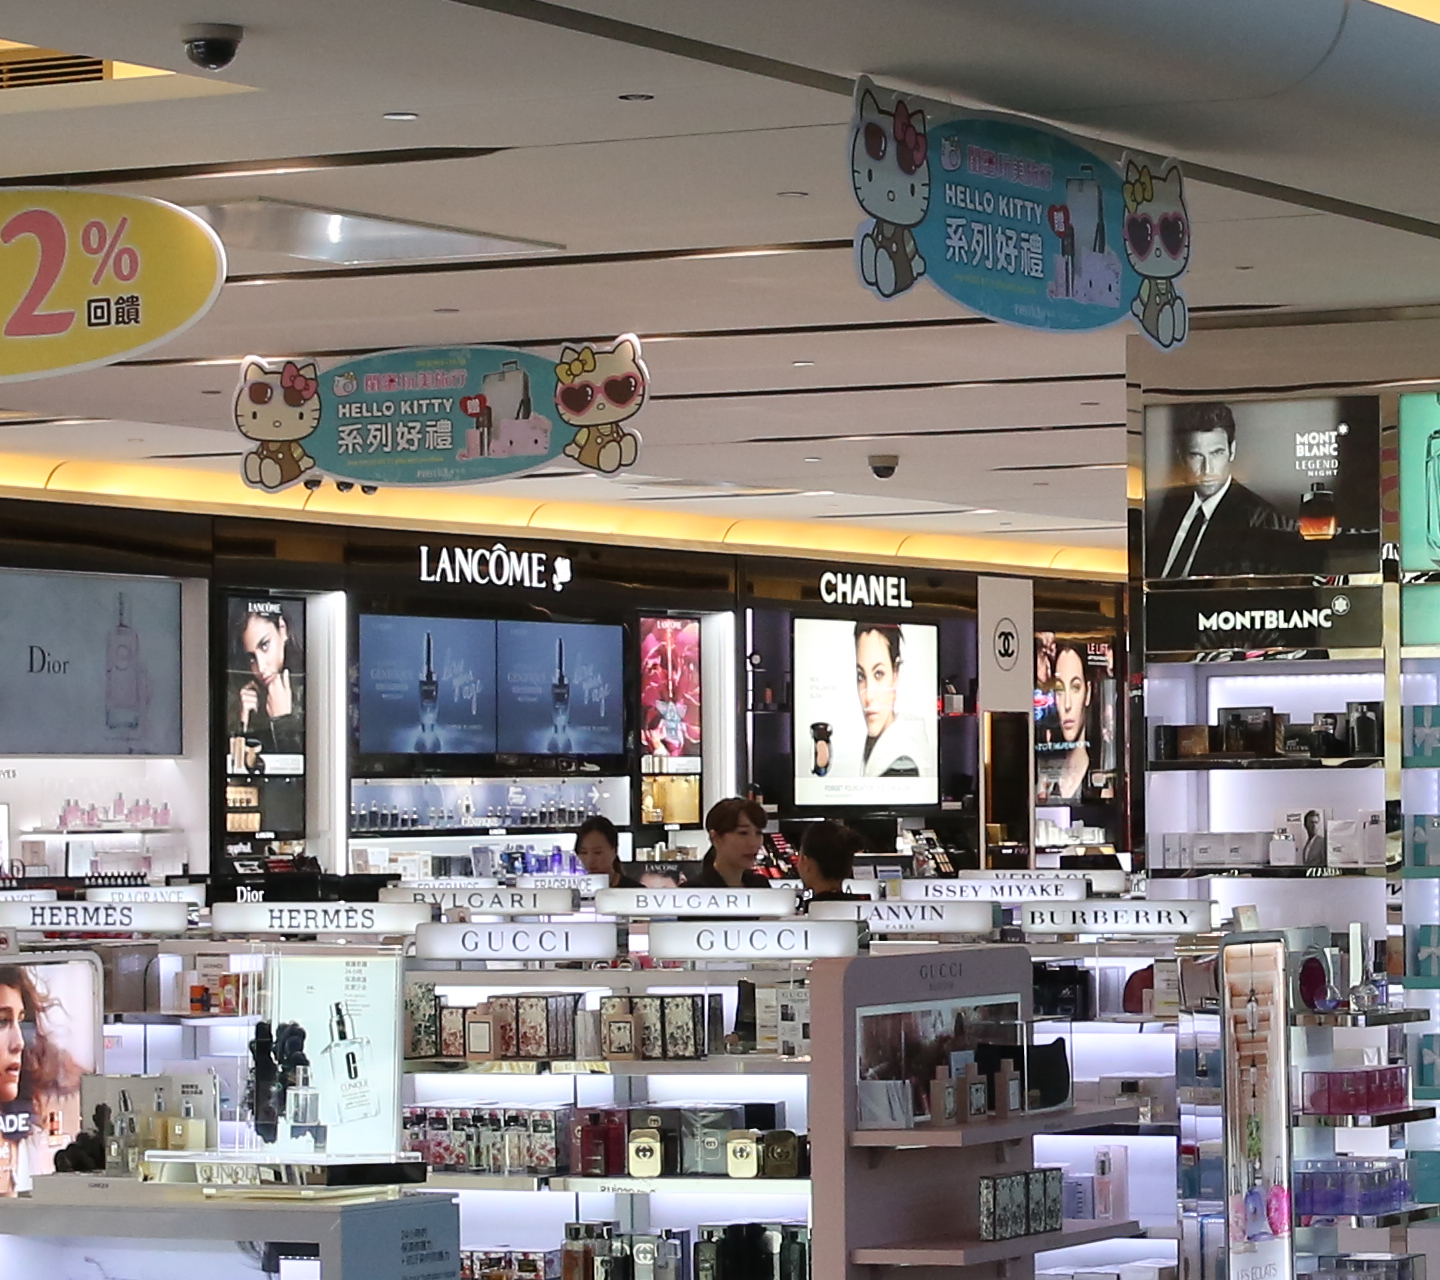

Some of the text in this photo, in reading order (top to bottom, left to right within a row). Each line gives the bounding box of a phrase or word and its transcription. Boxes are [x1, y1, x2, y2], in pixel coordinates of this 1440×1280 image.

[945, 183, 1043, 224] HELLO KITTY
[945, 217, 1044, 280] 系列好禮
[0, 208, 140, 337] 2%
[86, 295, 141, 327] 回饋
[337, 397, 454, 419] HELLO KITTY
[337, 420, 454, 455] 系列好禮
[1295, 431, 1338, 445] MONT
[1296, 443, 1338, 457] BLANC
[1295, 459, 1338, 470] LEGEND
[419, 543, 547, 589] LANCÔME
[820, 571, 913, 608] CHANEL
[1198, 608, 1332, 631] MONTBLANC
[27, 644, 70, 675] Dior
[236, 885, 265, 903] Dior
[533, 877, 593, 892] FRAGRANCE
[923, 882, 1065, 899] ISSEY MIYAKE
[111, 890, 184, 902] FRAGRANCE
[412, 891, 540, 908] BVLGARI
[635, 893, 751, 910] BVLGARI
[30, 902, 133, 926] HERMÈS
[268, 905, 375, 929] HERMÈS
[855, 903, 946, 922] LANVIN
[1029, 908, 1197, 926] BURBERRY
[884, 923, 916, 931] PARIS
[460, 929, 572, 953] GUCCI
[696, 928, 811, 953] GUCCI
[920, 962, 963, 979] GUCCI
